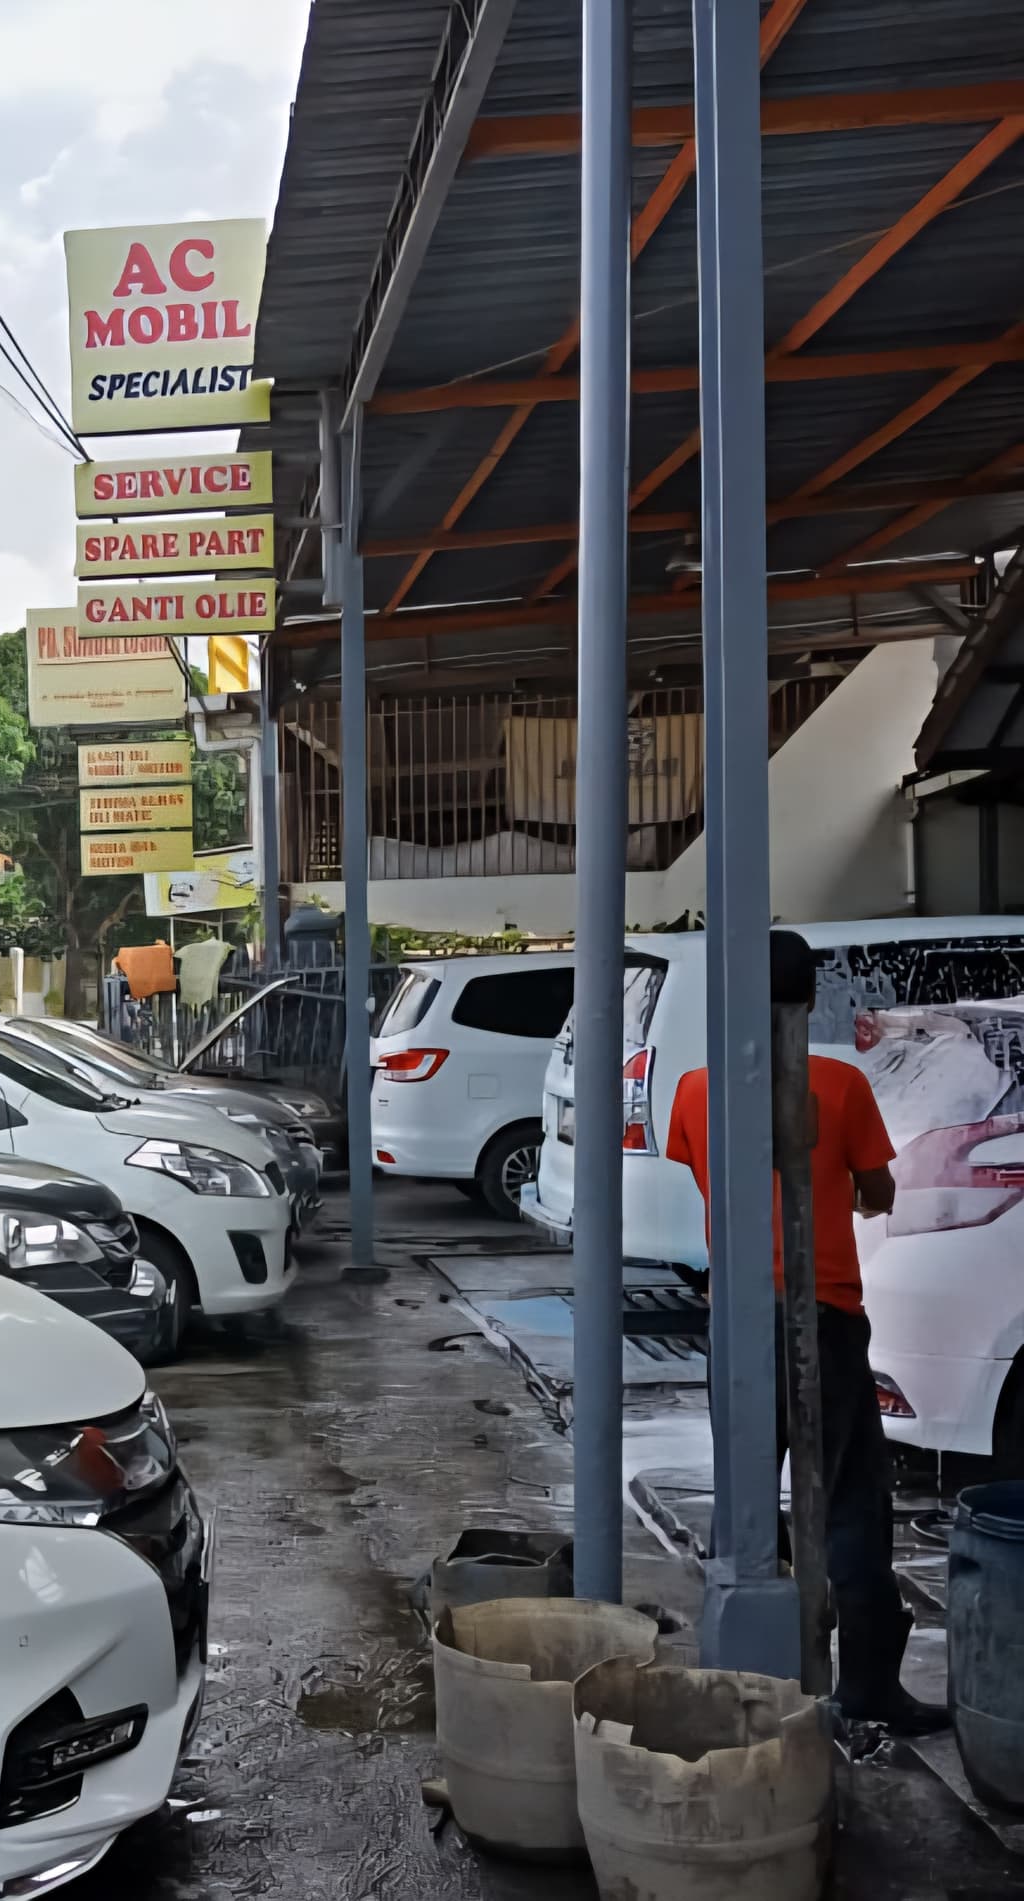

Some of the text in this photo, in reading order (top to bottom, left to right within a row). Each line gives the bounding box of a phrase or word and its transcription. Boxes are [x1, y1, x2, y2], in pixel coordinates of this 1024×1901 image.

[113, 239, 215, 297] AC
[84, 300, 251, 348] MOBIL
[88, 365, 254, 401] SPECIALIST
[93, 464, 252, 501] SERVICE
[84, 528, 265, 562] SPARE PART
[85, 592, 267, 624] GANTI OLIE
